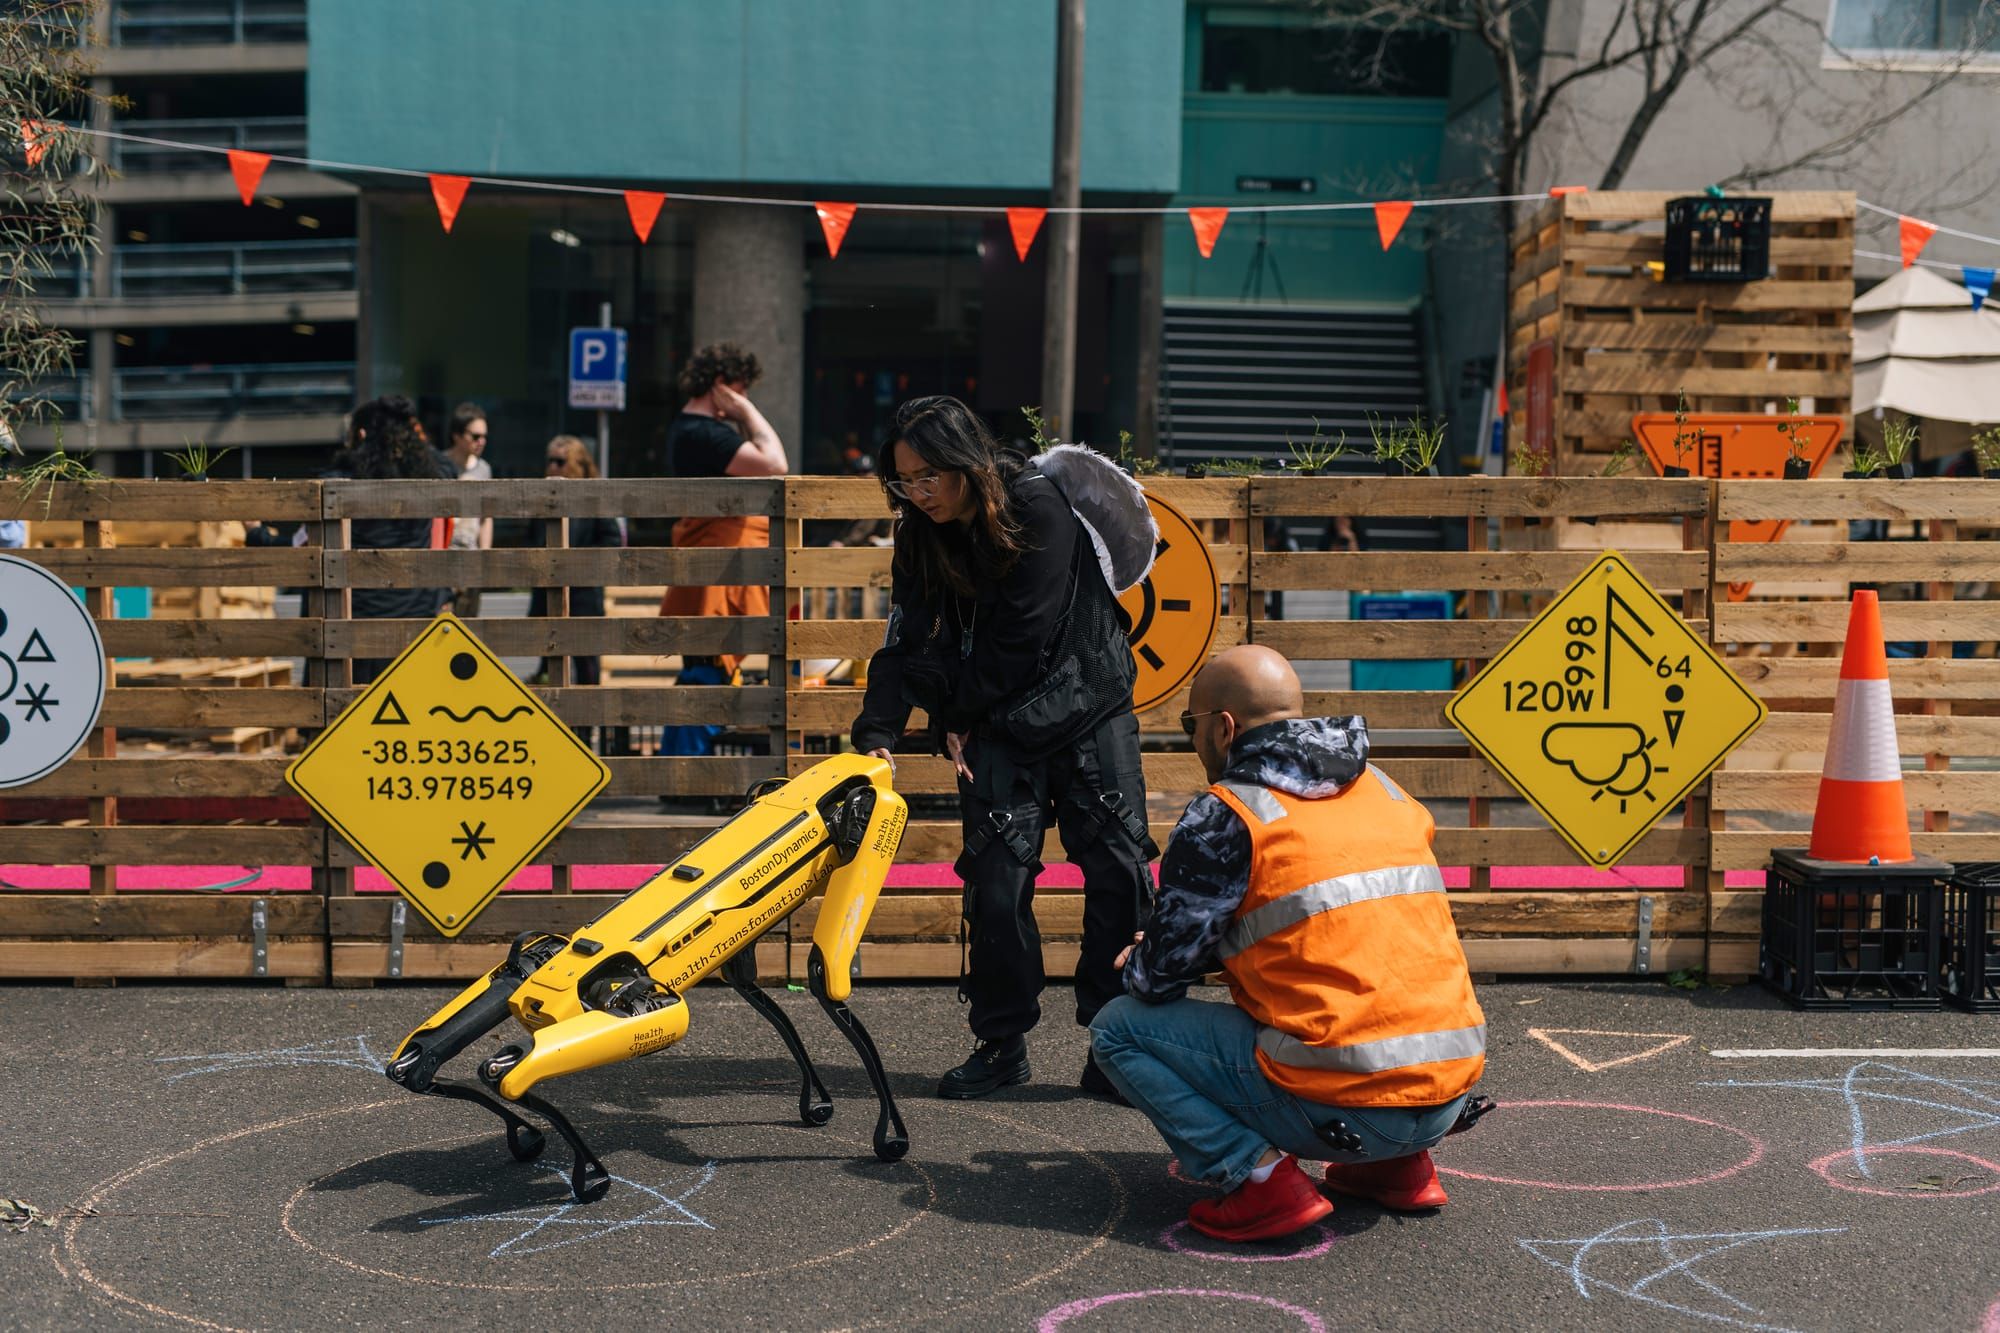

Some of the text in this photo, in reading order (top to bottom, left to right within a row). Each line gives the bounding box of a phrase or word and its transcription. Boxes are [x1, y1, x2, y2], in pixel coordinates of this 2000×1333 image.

[583, 338, 607, 375] P
[1656, 655, 1692, 679] 64
[362, 740, 537, 766] -38.533625,
[367, 776, 534, 801] 143.978549
[873, 818, 890, 851] Health
[634, 1026, 664, 1042] Health
